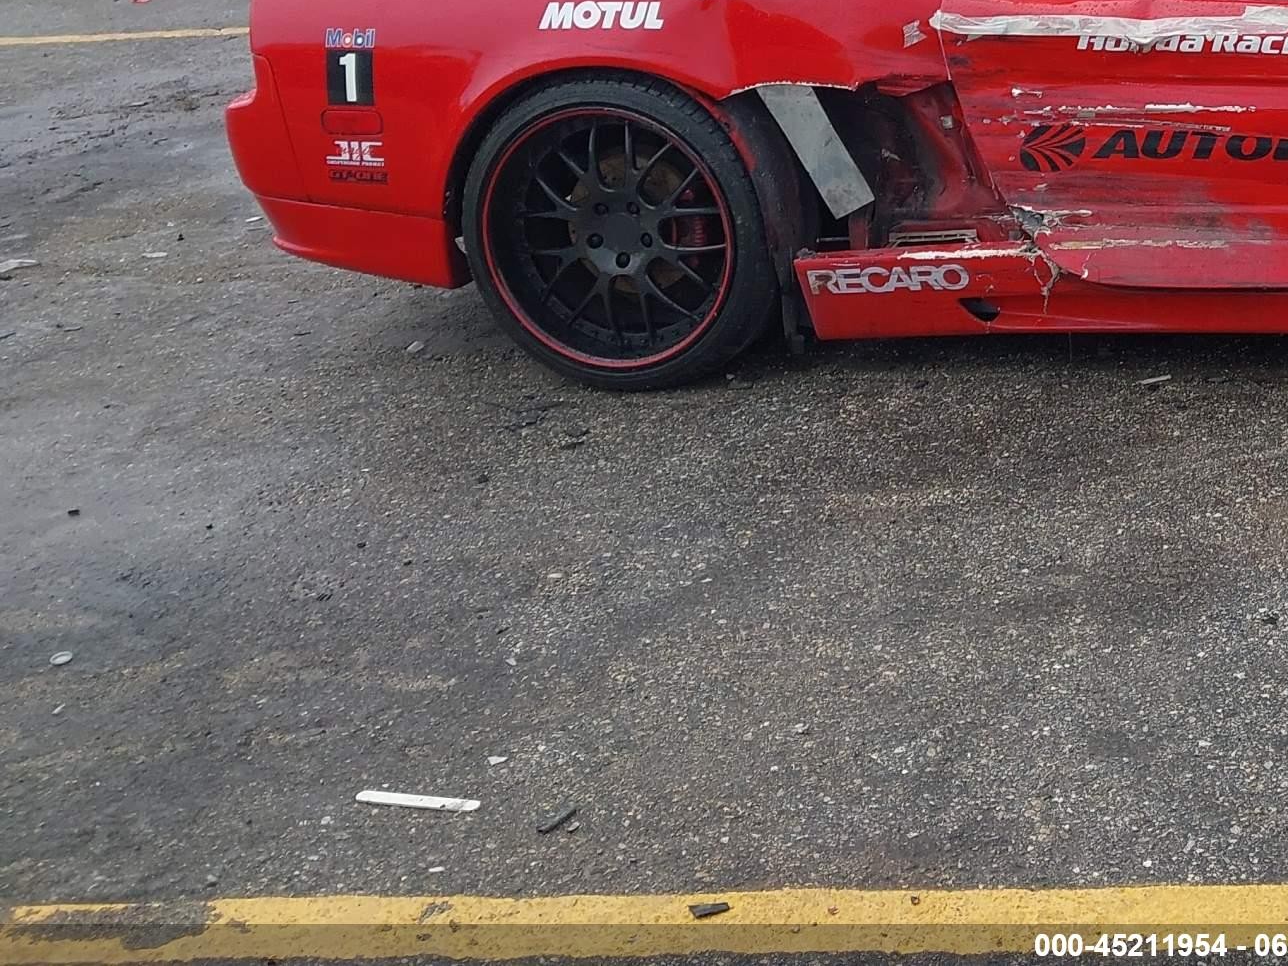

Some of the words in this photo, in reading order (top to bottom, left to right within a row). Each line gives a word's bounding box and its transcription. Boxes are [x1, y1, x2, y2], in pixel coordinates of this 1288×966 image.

[539, 0, 664, 30] MOTUL
[325, 28, 375, 48] Mobil
[339, 52, 357, 103] 1
[806, 264, 969, 295] RECARO
